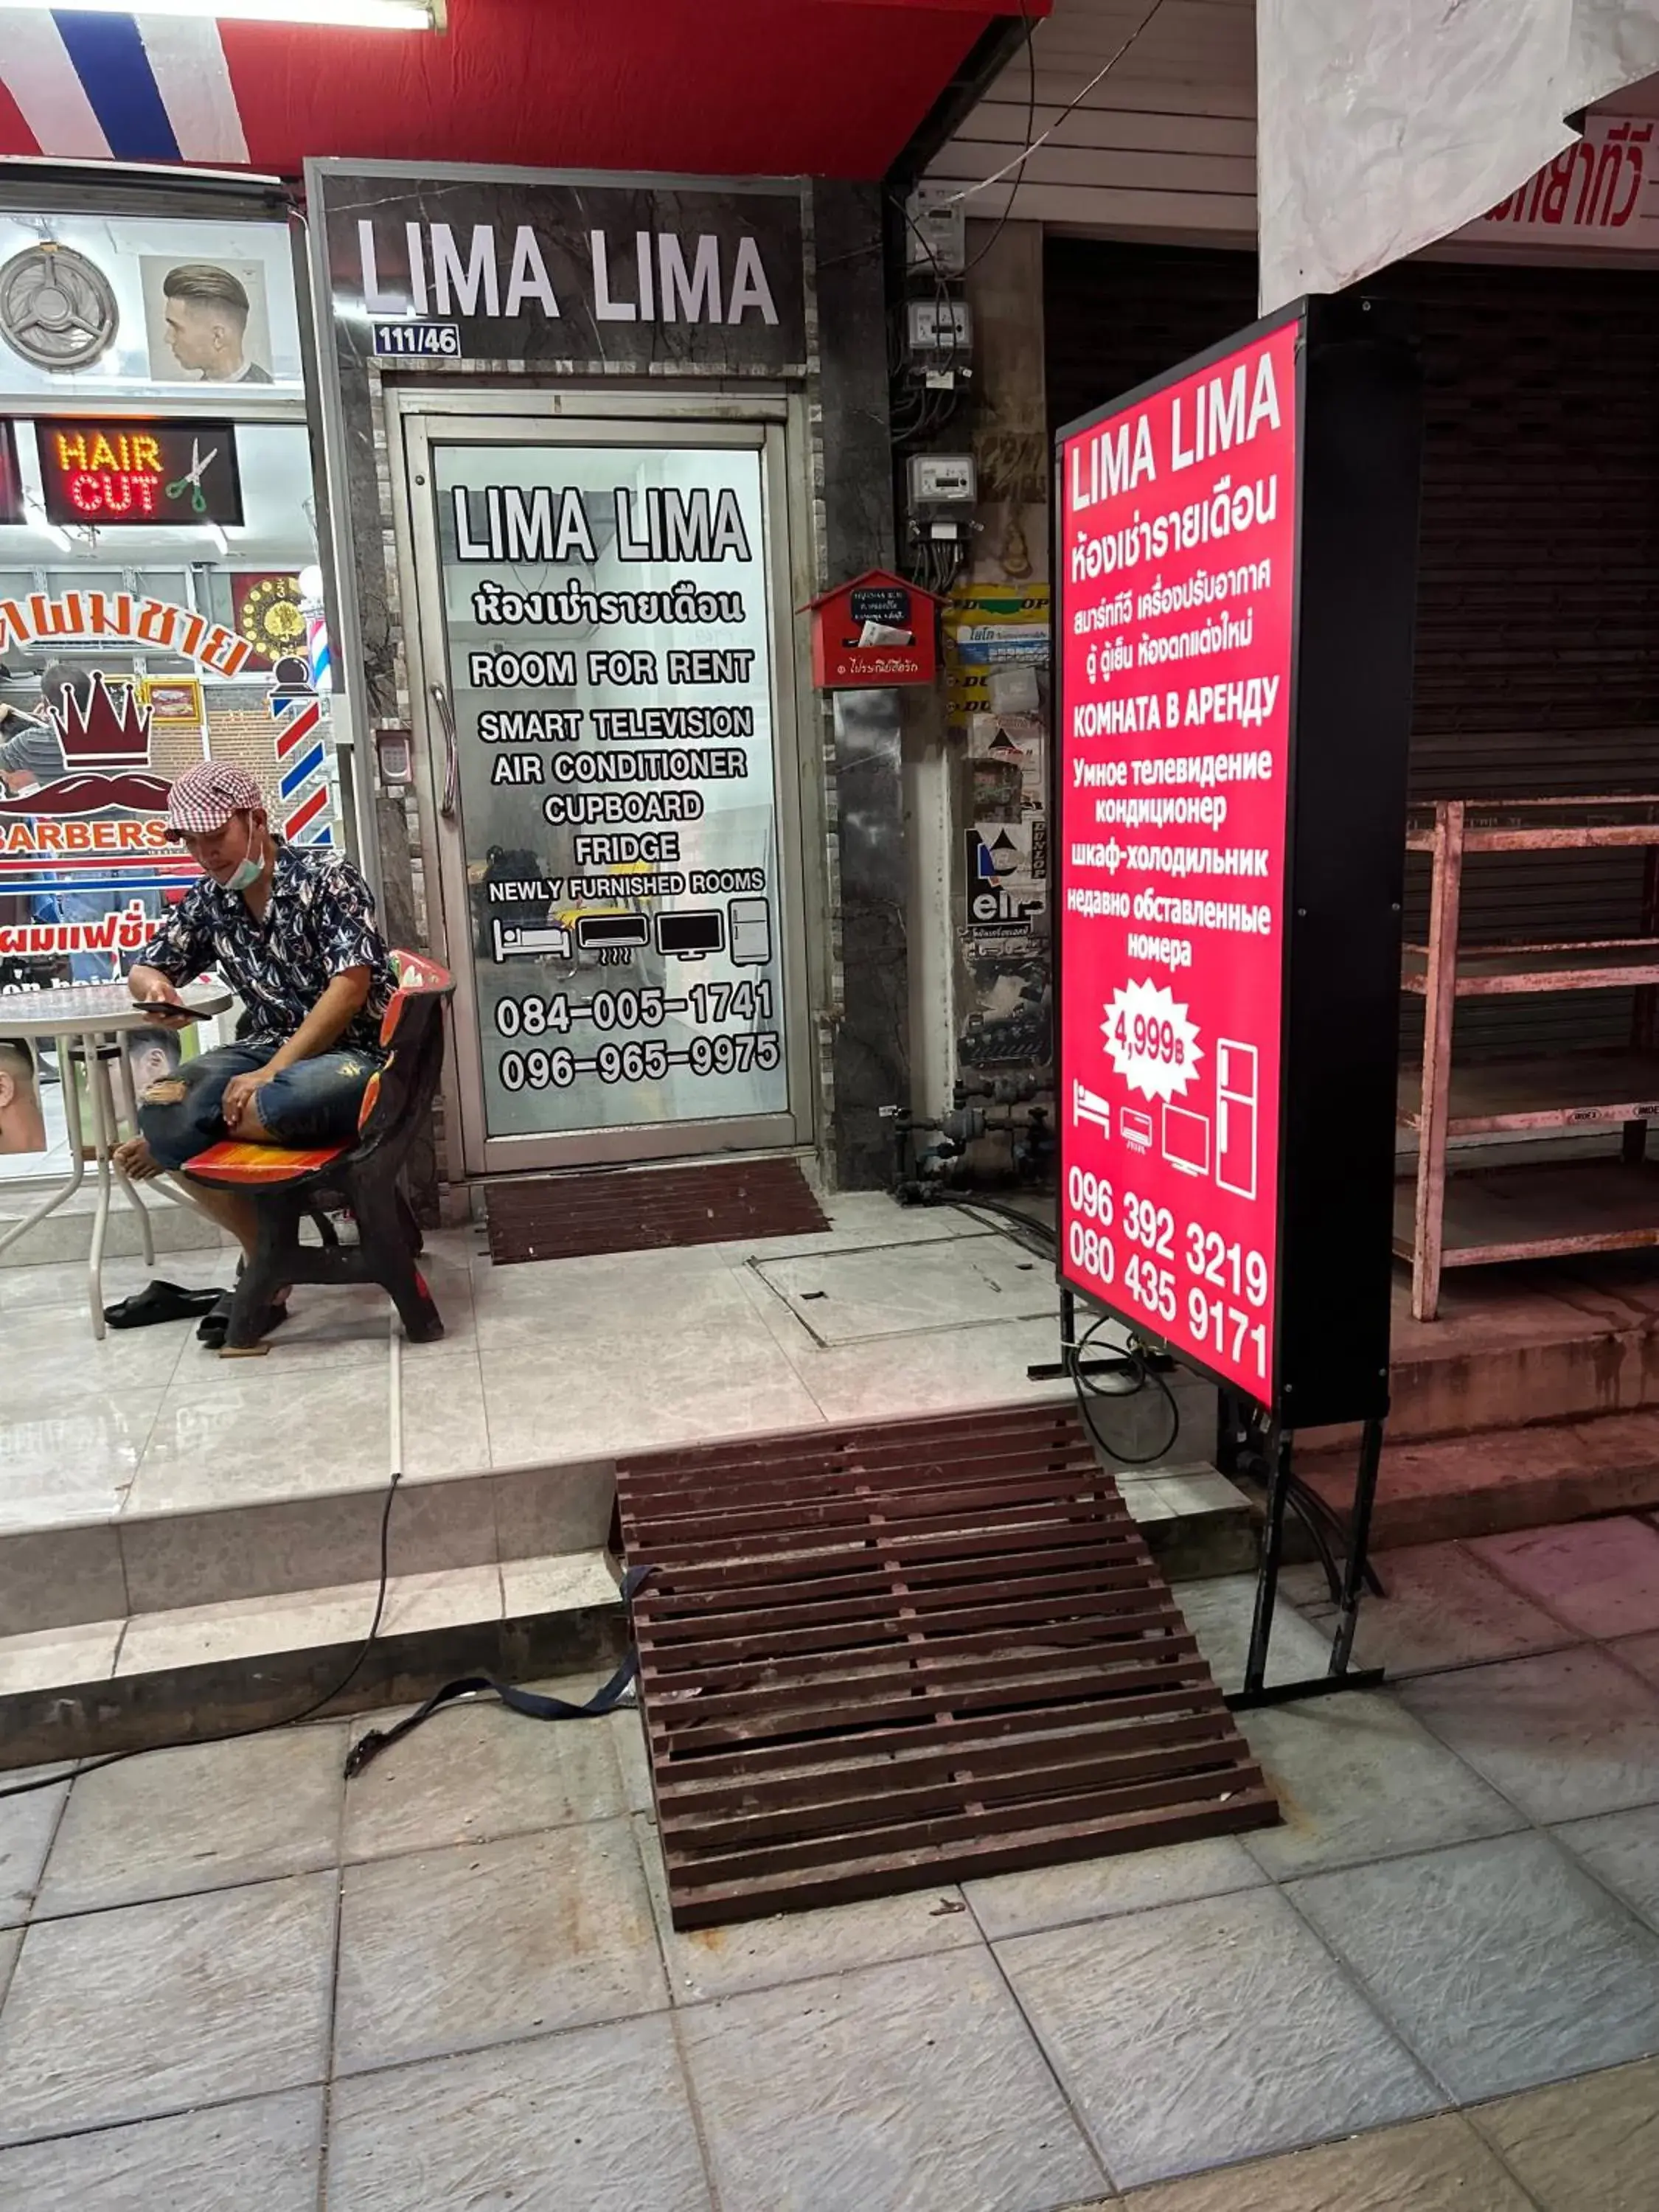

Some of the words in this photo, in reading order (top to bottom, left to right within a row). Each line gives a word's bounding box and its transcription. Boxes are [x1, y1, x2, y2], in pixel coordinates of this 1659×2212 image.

[358, 220, 560, 318] LIMA
[591, 229, 779, 325] LIMA
[379, 327, 456, 353] 111/46
[57, 432, 164, 472] HAIR
[1072, 414, 1156, 512] LIMA
[1172, 352, 1281, 472] LIMA
[72, 474, 159, 511] CUT
[452, 486, 597, 561] LIMA
[615, 487, 751, 563] LIMA
[1071, 474, 1277, 583] ห้องเช่ารายเดือน
[471, 578, 745, 624] ห้องเช่ารายเดือน
[1137, 557, 1271, 621] เครื่องปรับอากาศ
[470, 652, 576, 686] ROOM
[589, 651, 657, 686] FOR
[669, 650, 754, 684] RENT
[478, 711, 582, 742] SMART
[590, 707, 754, 739] TELEVISION
[1074, 694, 1161, 737] КОМНАТА
[1166, 692, 1180, 728] В
[1184, 675, 1280, 728] АРЕНДУ
[491, 754, 544, 785] AIR
[552, 749, 747, 782] CONDITIONER
[1074, 757, 1127, 787] Умное
[1131, 750, 1273, 788] телевидение
[543, 791, 703, 824] CUPBOARD
[1096, 795, 1227, 832] кондиционер
[0, 818, 184, 854] ARBERS
[575, 833, 680, 864] FRIDGE
[1071, 837, 1270, 878] шкаф-холодильник
[489, 880, 563, 902] NEWLY
[569, 874, 684, 899] FURNISHED
[691, 869, 765, 894] ROOMS
[1067, 887, 1130, 918] недавно
[1133, 887, 1272, 935] обставленные
[1127, 933, 1192, 972] номера
[495, 980, 772, 1037] 084-005-1741
[500, 1032, 779, 1091] 096-965-9975
[1068, 1165, 1114, 1227] 096
[1123, 1191, 1175, 1260] 392
[1186, 1222, 1268, 1307] 3219
[1069, 1221, 1115, 1284] 080
[1124, 1254, 1177, 1322] 435
[1187, 1287, 1267, 1379] 9171
